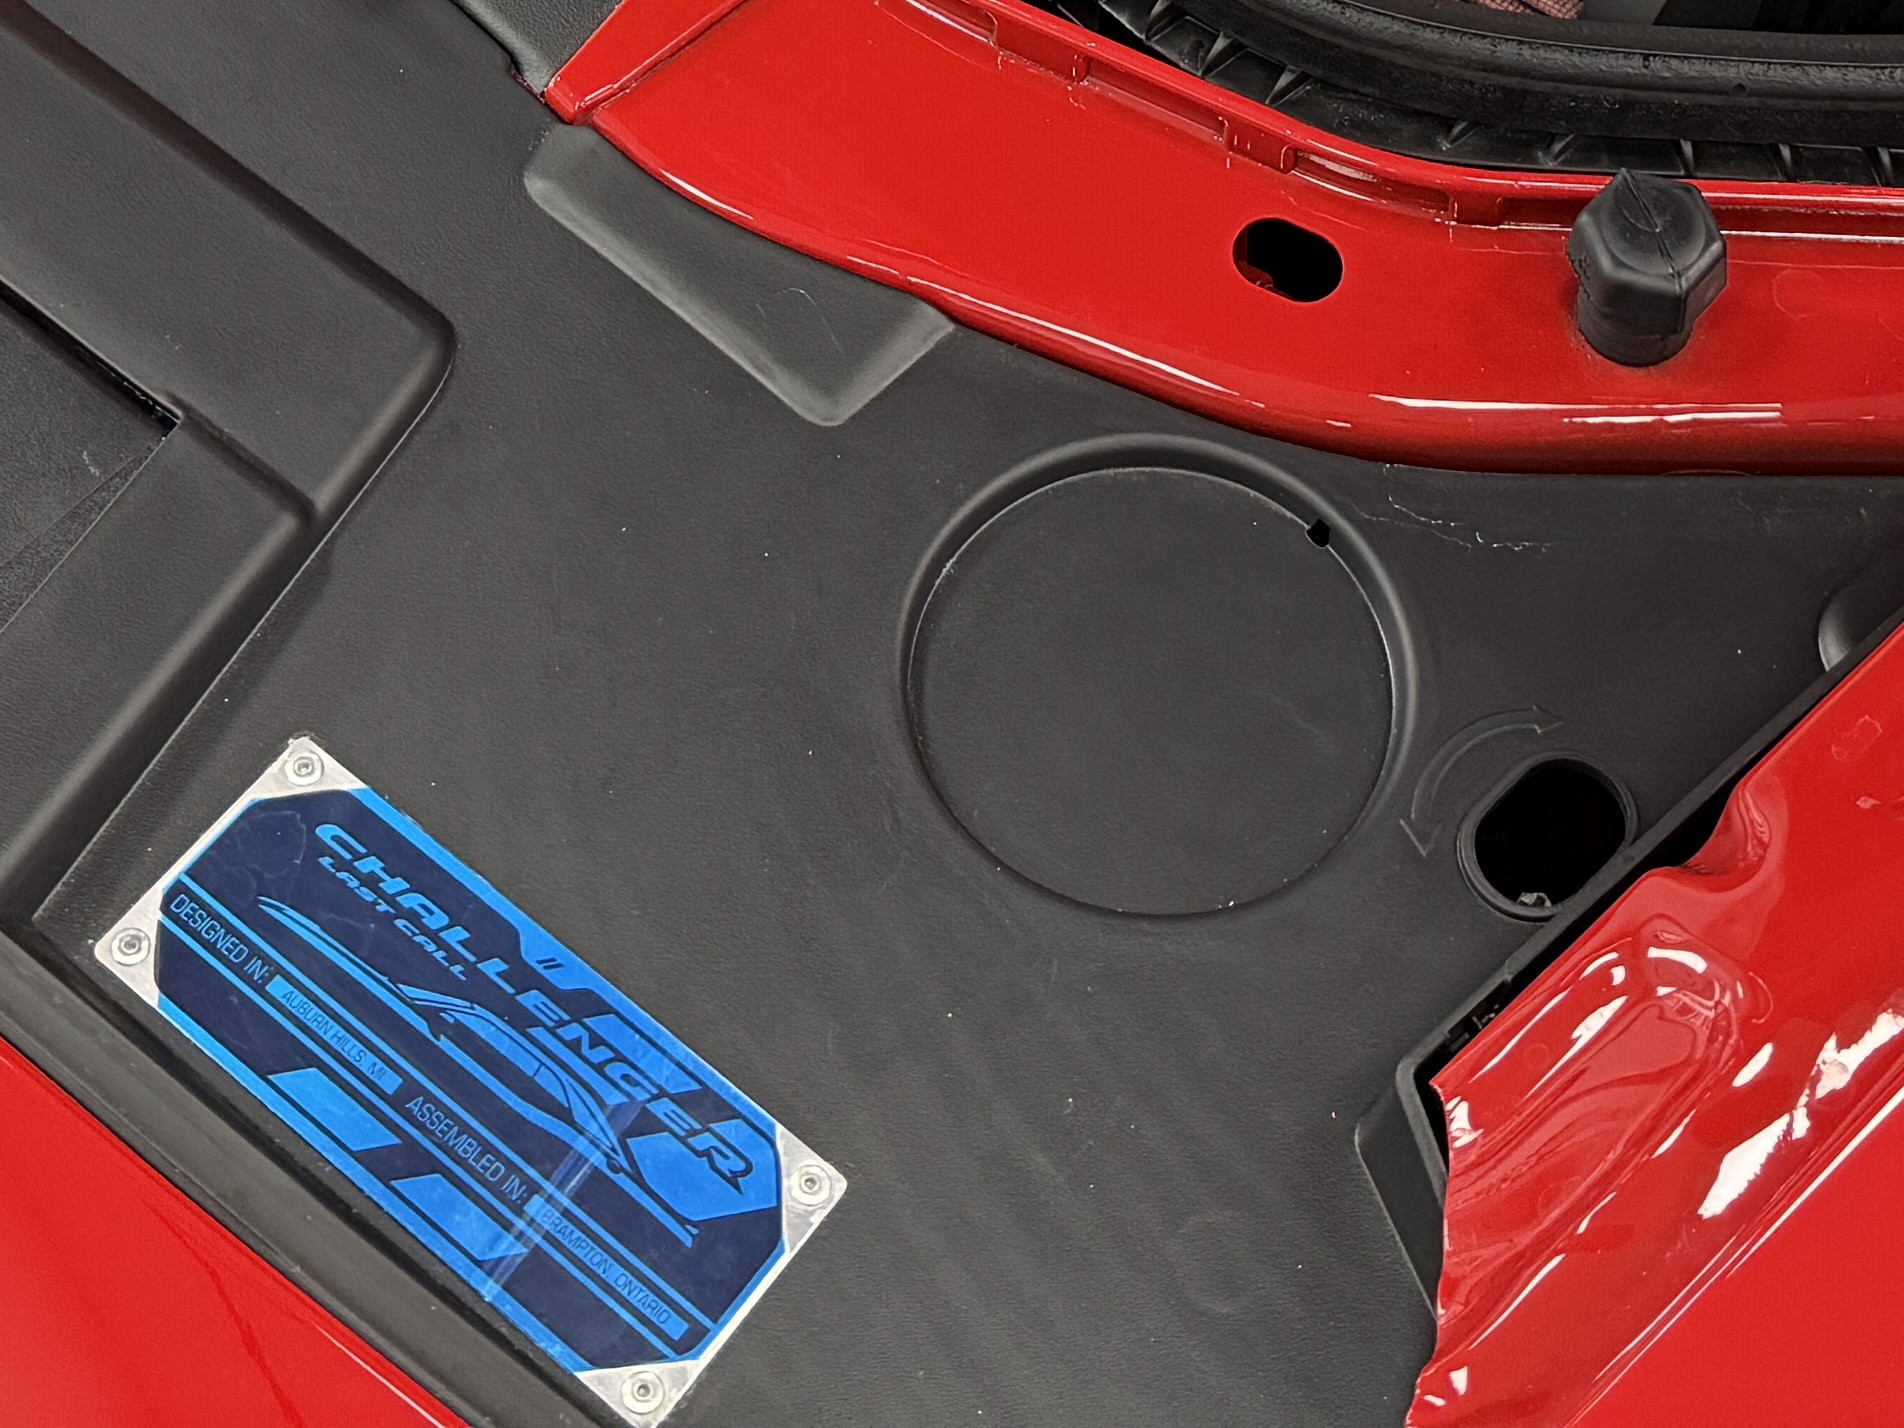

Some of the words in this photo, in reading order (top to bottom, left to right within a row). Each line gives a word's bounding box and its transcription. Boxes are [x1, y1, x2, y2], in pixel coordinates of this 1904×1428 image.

[169, 893, 250, 964] DESIGNED
[243, 955, 270, 984] IN:
[317, 855, 397, 915] LAST
[393, 918, 468, 982] CALL
[281, 989, 335, 1038] AUBURN
[367, 1060, 388, 1081] MI
[314, 823, 754, 1196] CHALLENGER
[404, 1095, 507, 1183] ASSEMBLED
[500, 1174, 529, 1205] IN:
[614, 1273, 672, 1326] ONTARIO
